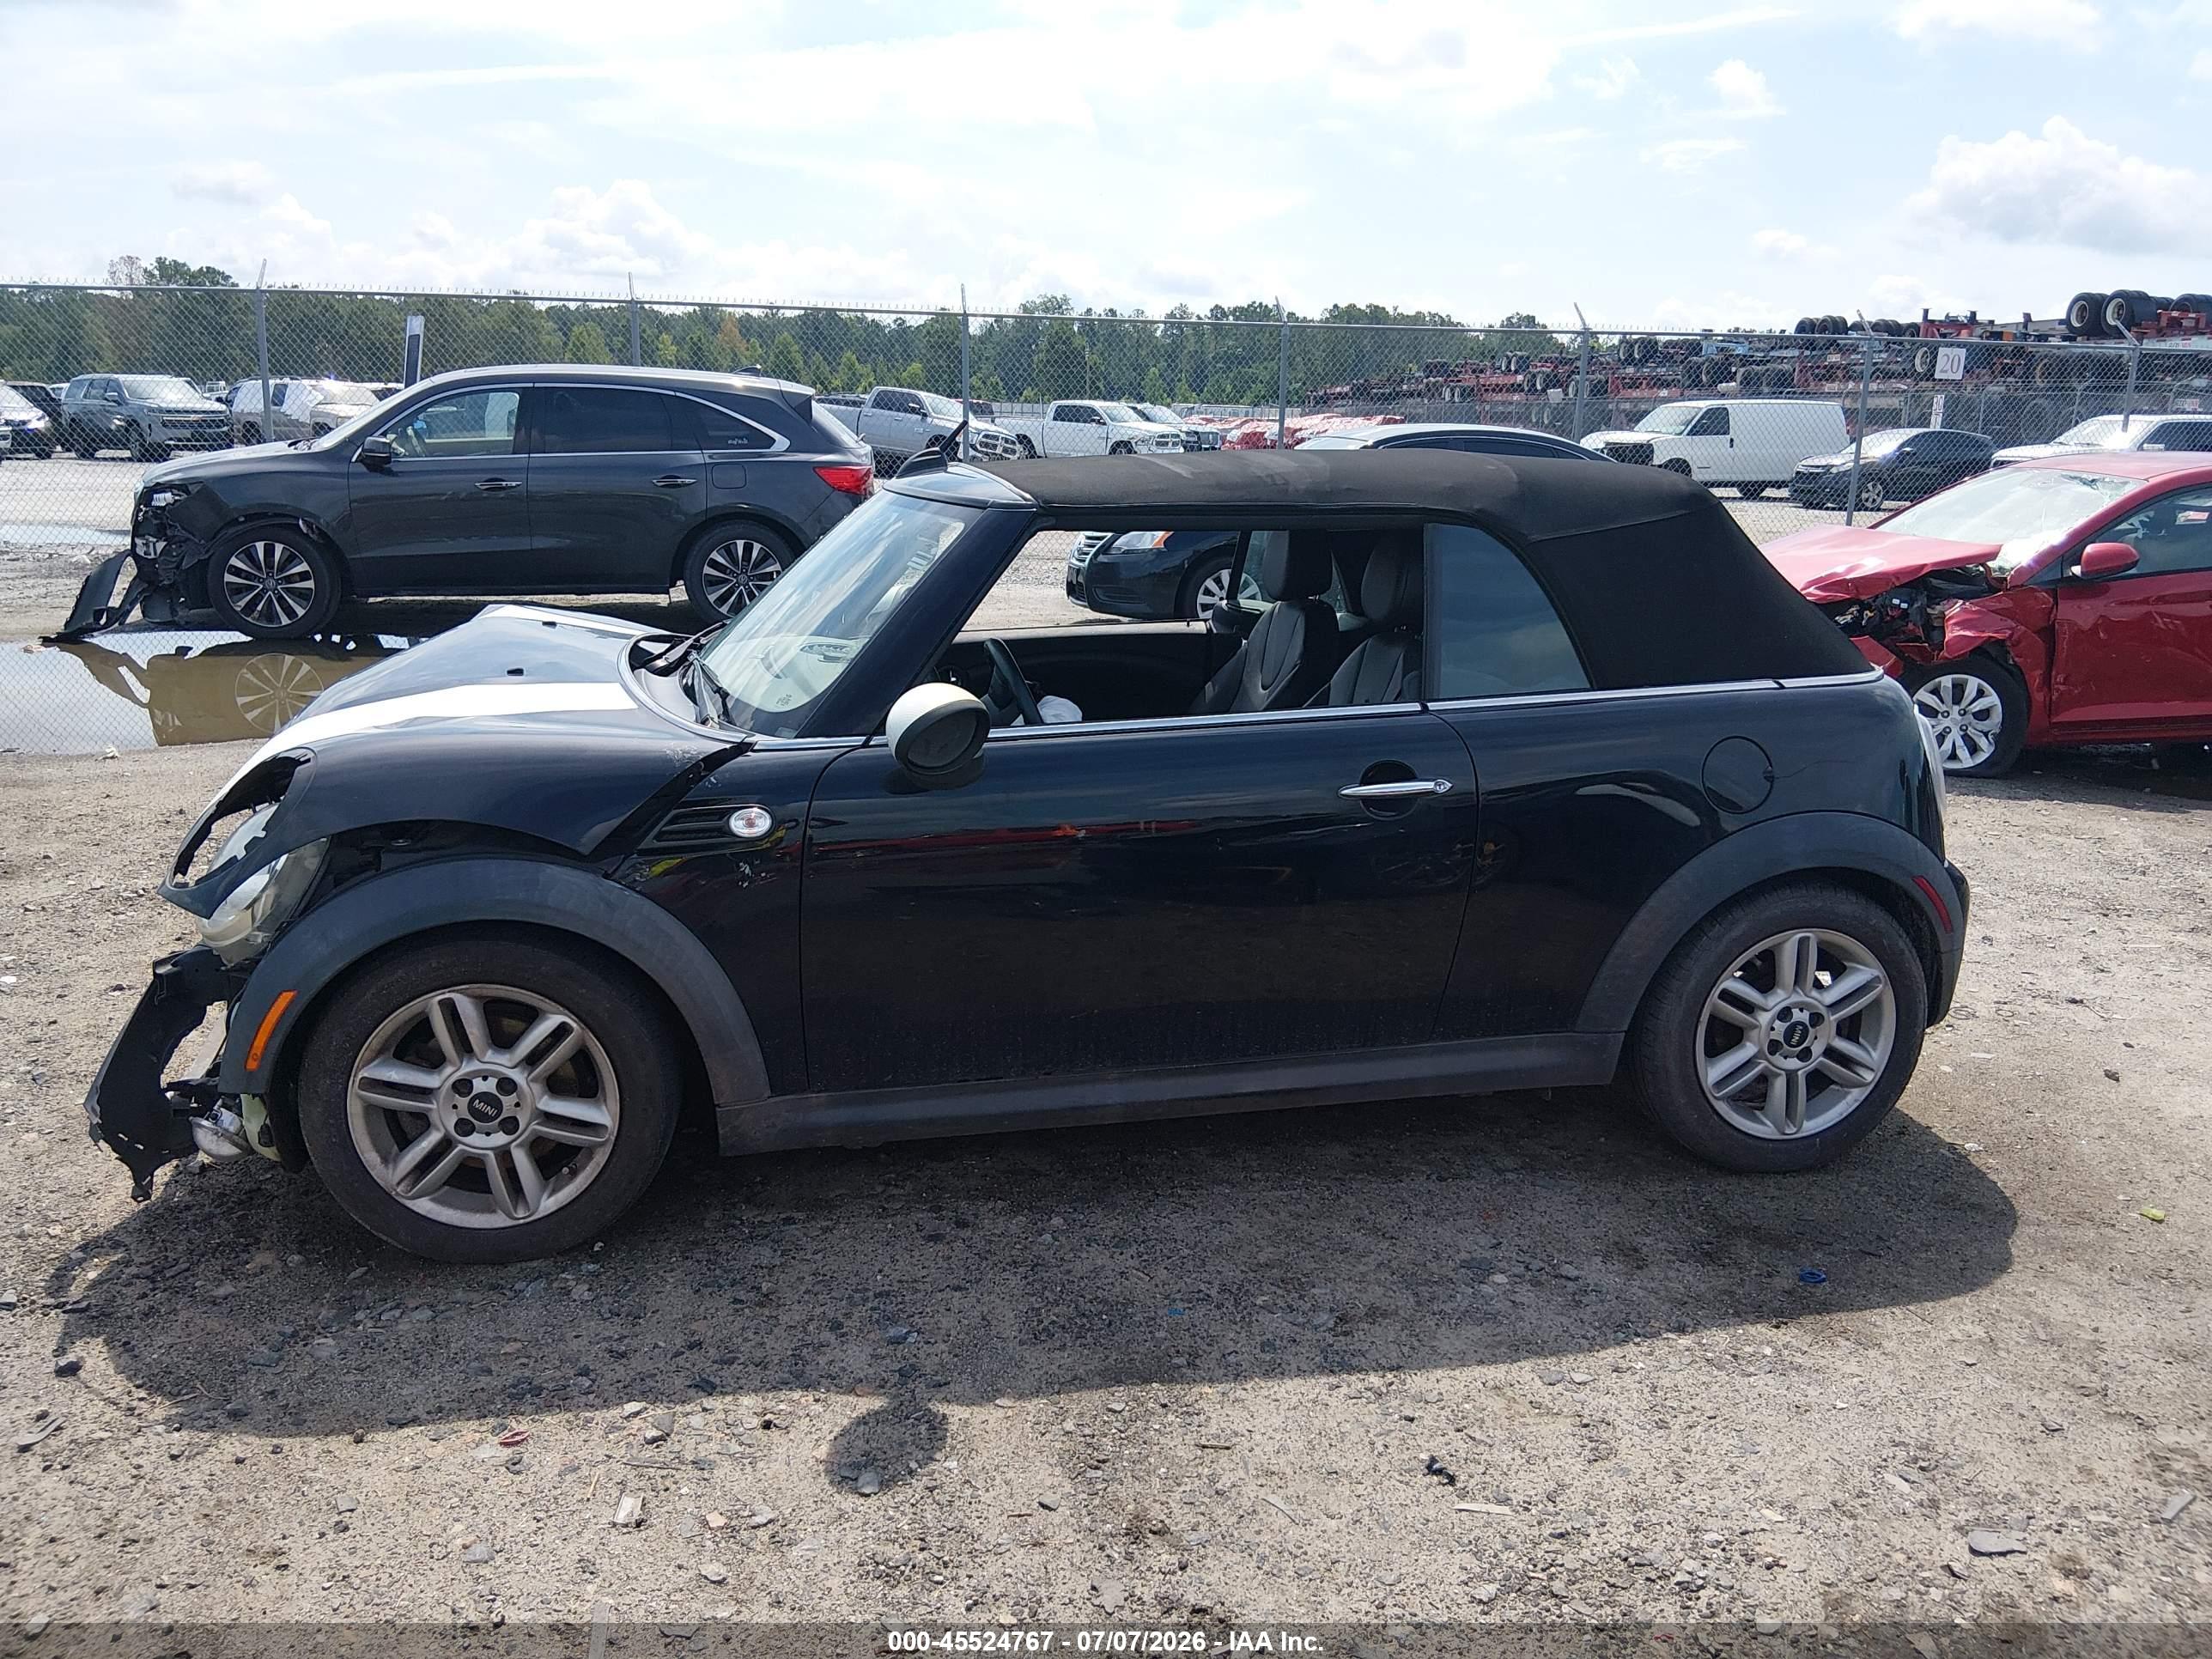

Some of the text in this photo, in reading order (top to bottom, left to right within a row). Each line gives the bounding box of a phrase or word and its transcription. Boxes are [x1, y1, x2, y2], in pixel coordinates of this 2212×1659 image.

[1939, 353, 1961, 374] 20
[1790, 1024, 1803, 1045] MINI
[472, 1098, 498, 1117] MINI
